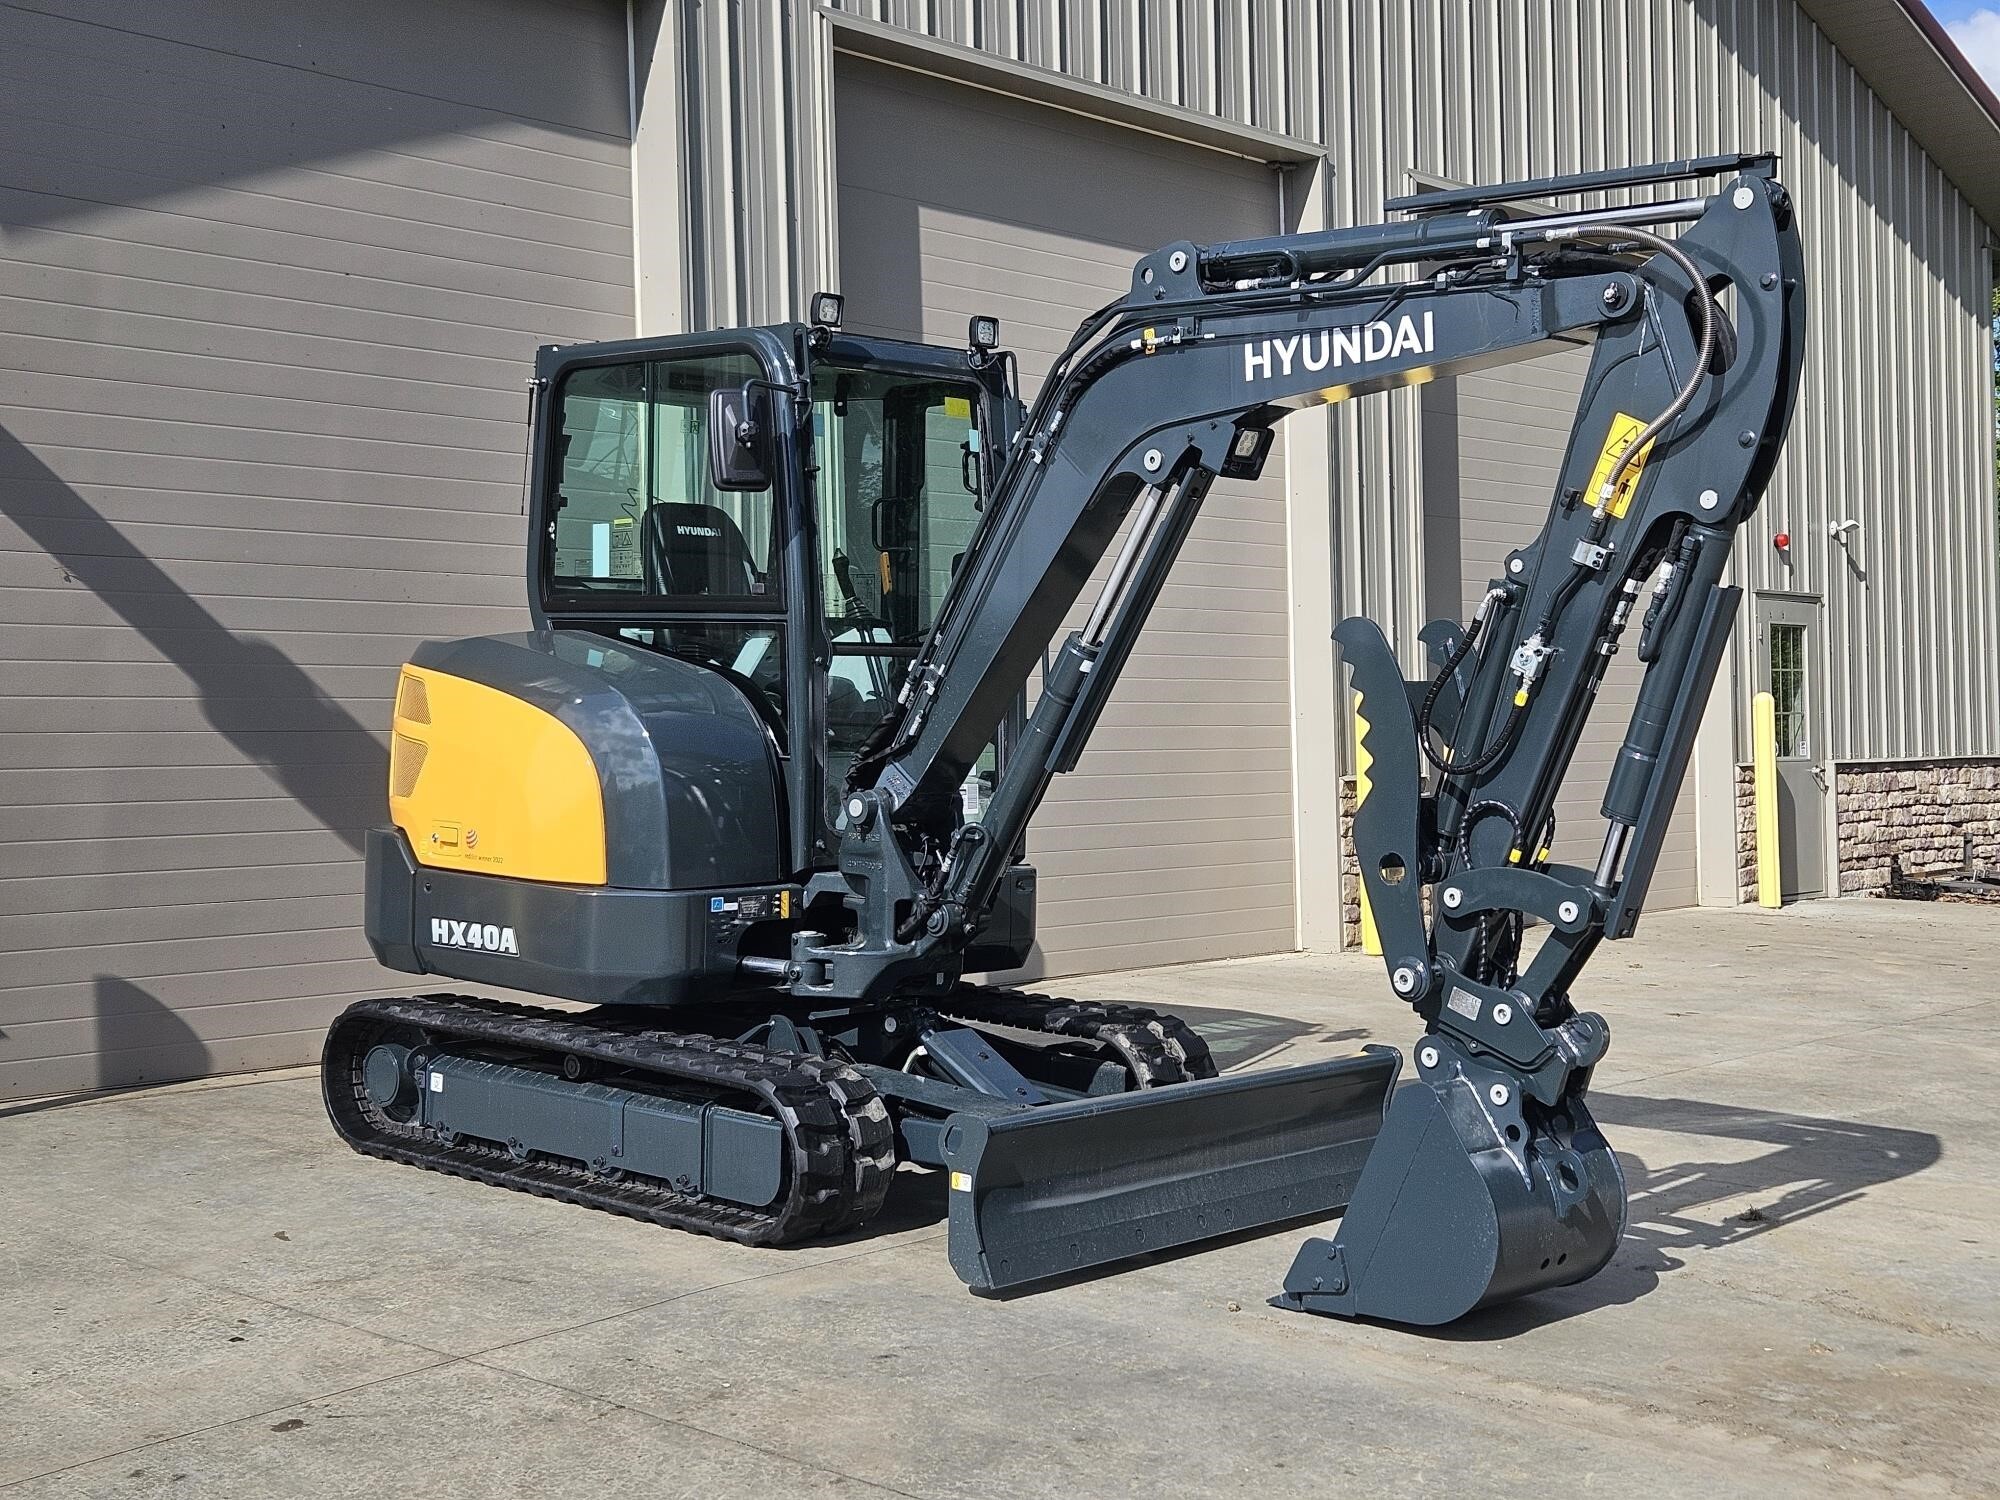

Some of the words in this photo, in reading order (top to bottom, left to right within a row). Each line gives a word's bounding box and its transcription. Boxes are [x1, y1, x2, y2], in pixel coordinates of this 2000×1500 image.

[1244, 310, 1434, 382] HYUNDAI
[676, 525, 722, 537] HYUNDAI
[431, 917, 518, 955] HX40A
